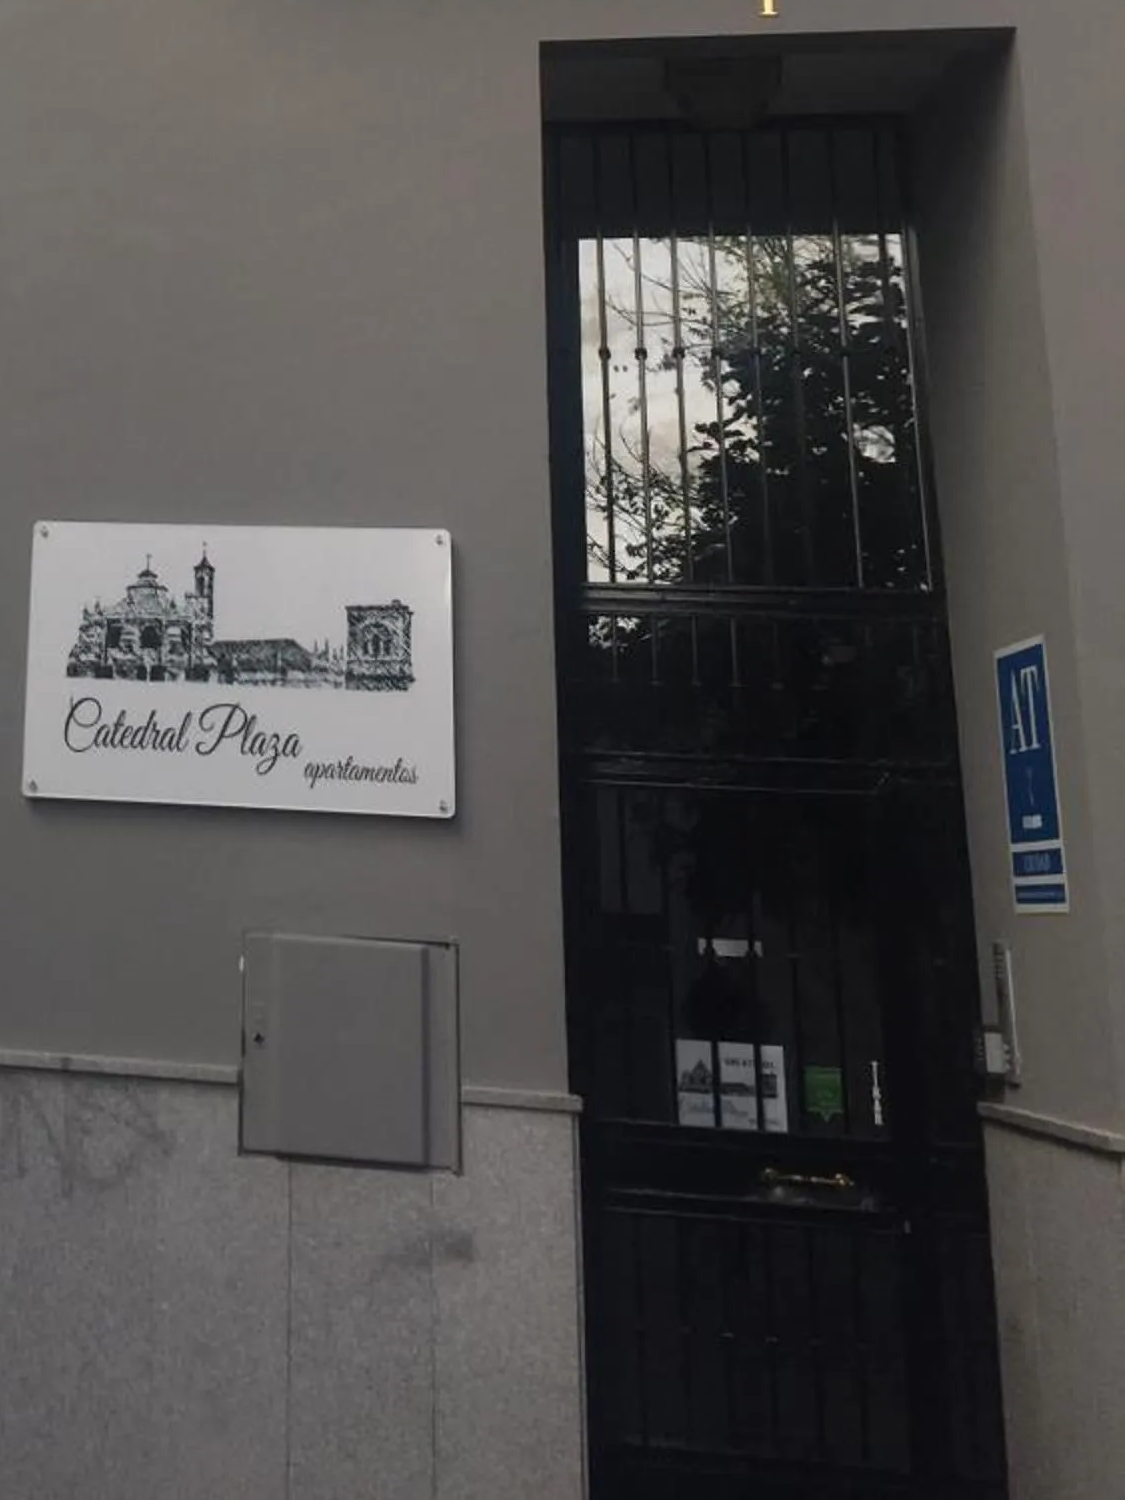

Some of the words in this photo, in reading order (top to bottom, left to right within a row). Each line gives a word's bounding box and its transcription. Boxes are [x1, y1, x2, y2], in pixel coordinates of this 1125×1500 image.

[64, 696, 193, 754] Catedral
[195, 702, 303, 776] Plaza
[1009, 665, 1042, 756] AT
[303, 754, 420, 790] apartamentos
